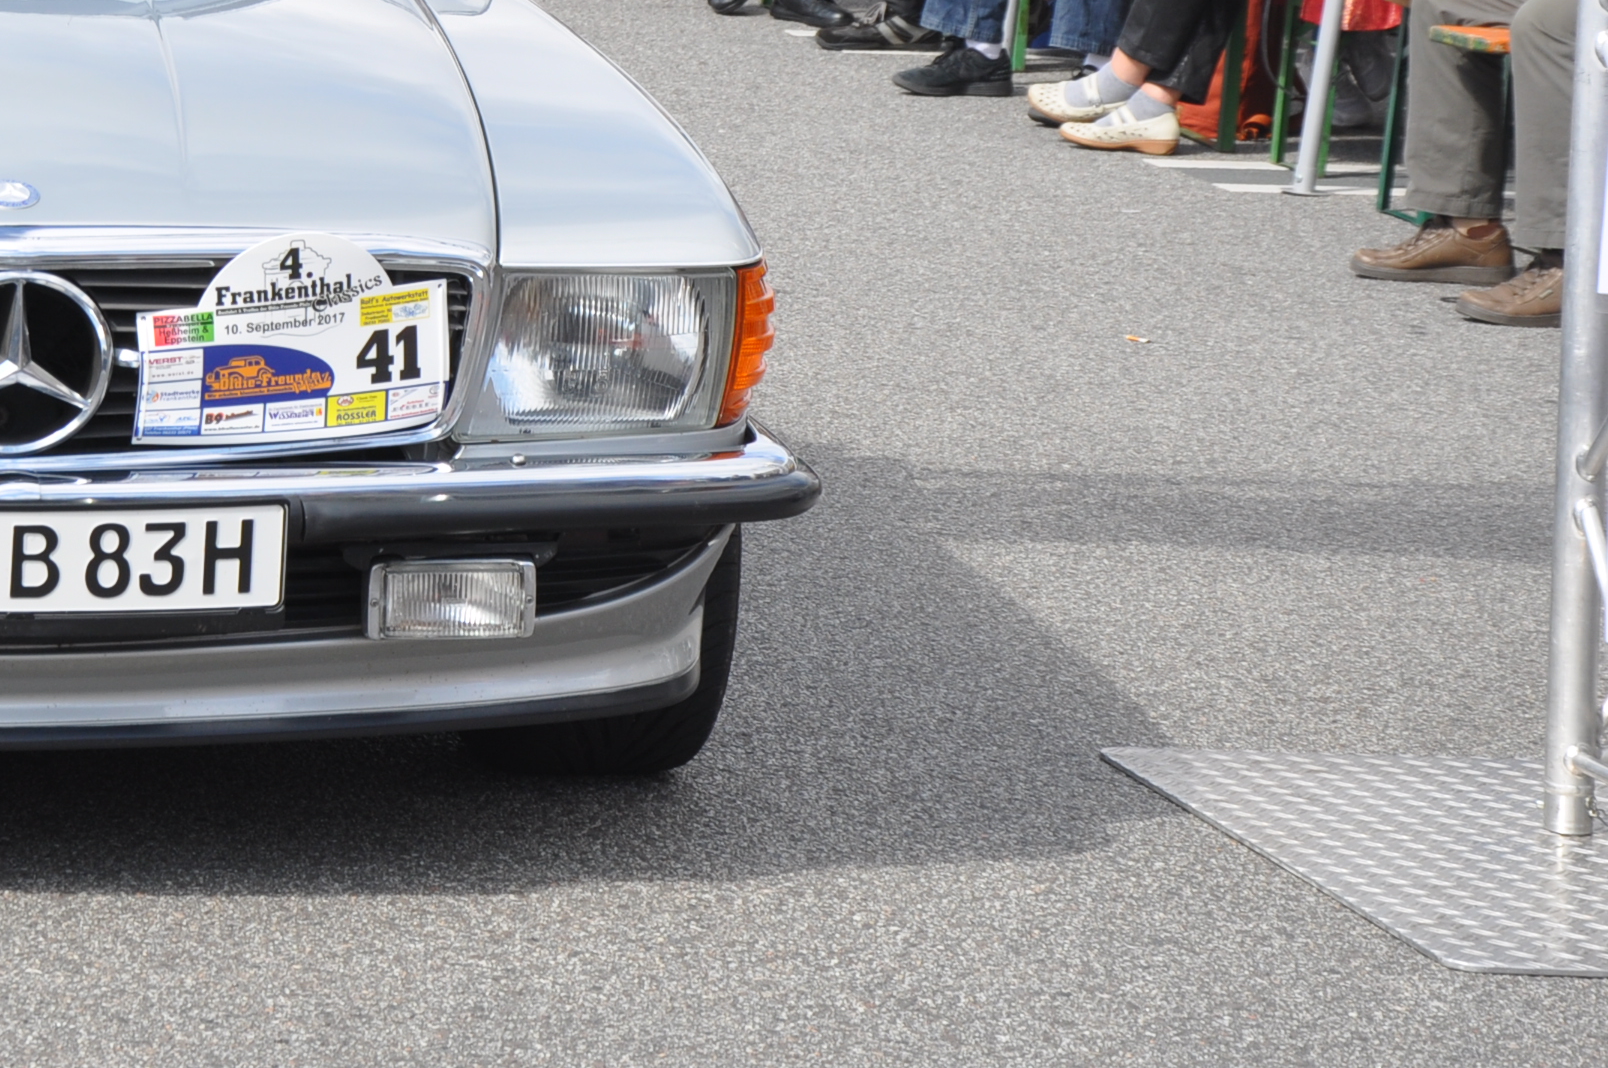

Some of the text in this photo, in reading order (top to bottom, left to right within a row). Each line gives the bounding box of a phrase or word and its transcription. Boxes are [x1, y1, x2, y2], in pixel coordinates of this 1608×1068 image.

[279, 247, 314, 281] 4.
[215, 273, 353, 307] Frankenthal
[312, 274, 383, 313] Classics
[153, 313, 213, 325] PIZZABELLA
[202, 325, 209, 333] &
[224, 312, 346, 335] 10. September 2017
[164, 334, 205, 345] Eppstein
[356, 324, 421, 385] 41
[336, 410, 377, 422] RÖSSLER
[9, 524, 61, 599] B
[84, 519, 255, 599] 83H
